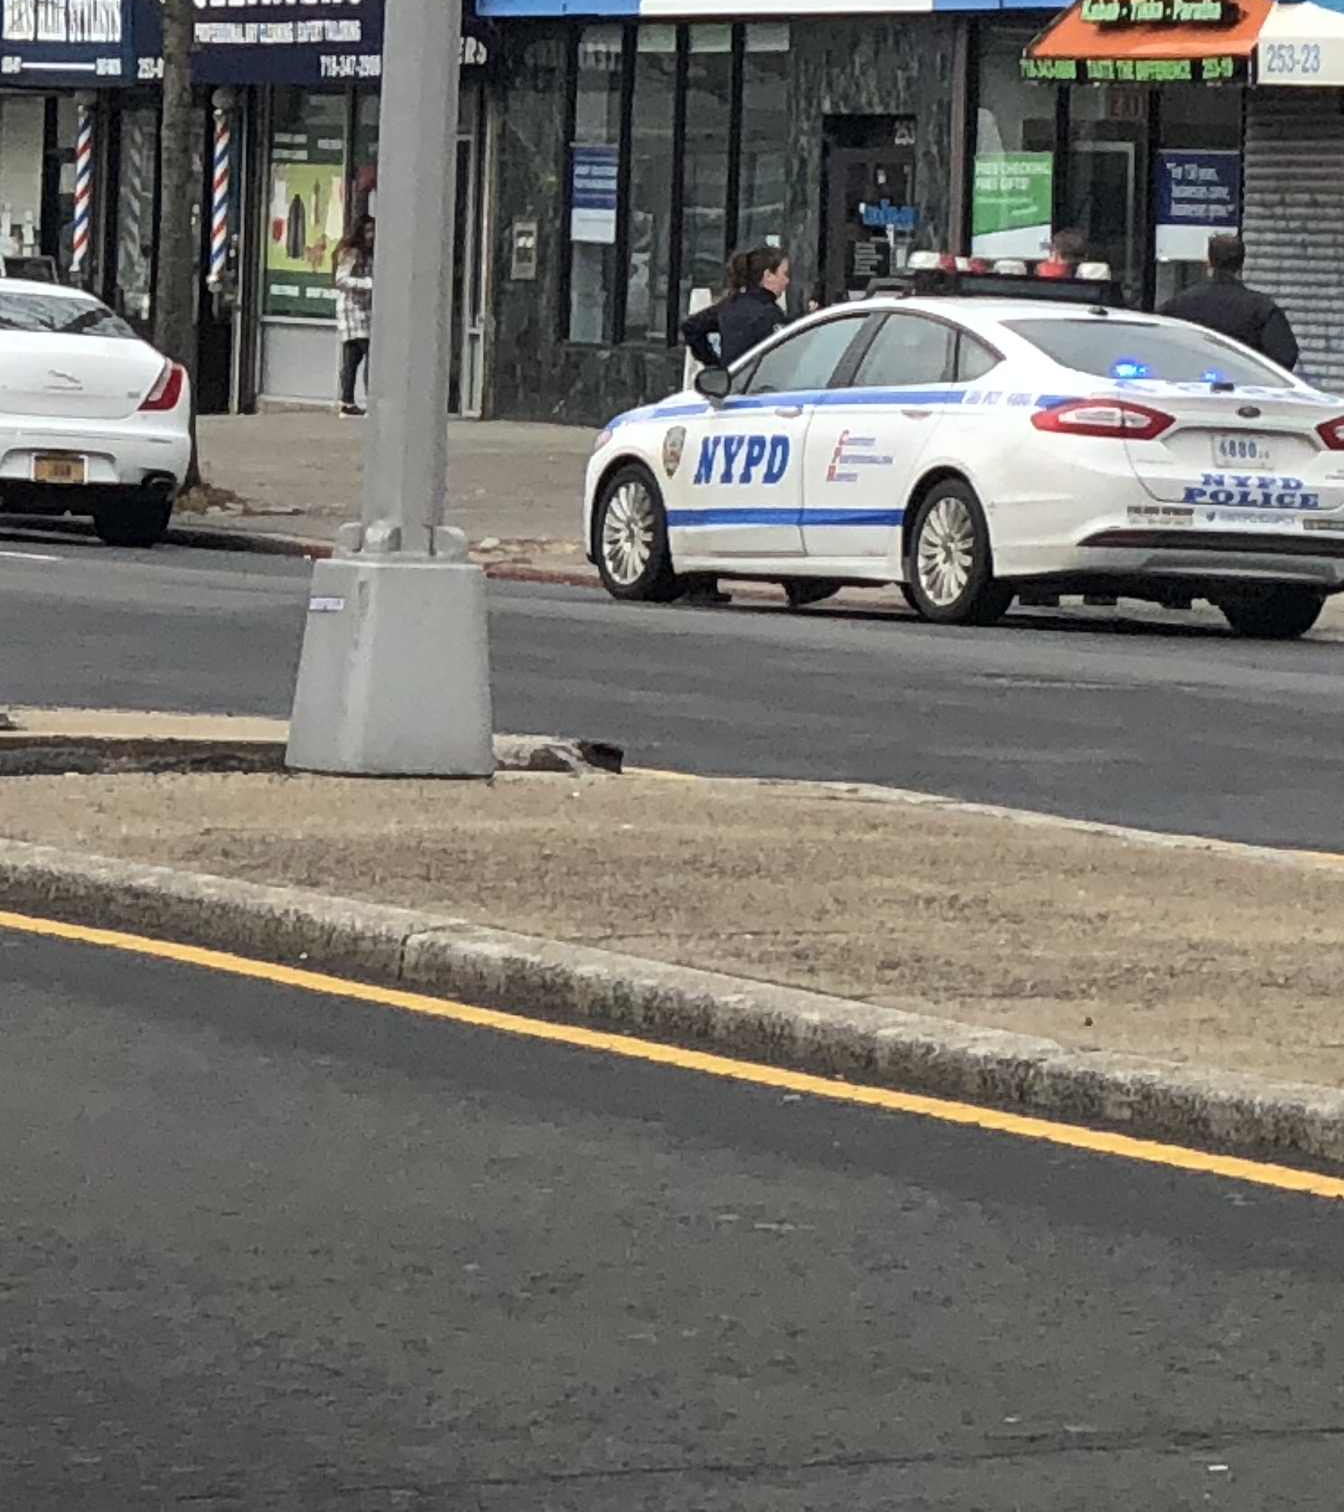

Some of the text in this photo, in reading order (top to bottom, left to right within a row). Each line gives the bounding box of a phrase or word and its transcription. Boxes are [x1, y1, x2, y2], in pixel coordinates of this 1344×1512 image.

[1266, 44, 1321, 73] 253-23
[694, 434, 791, 485] NYPD
[1201, 473, 1304, 490] NYPD
[1181, 487, 1320, 510] POLICE
